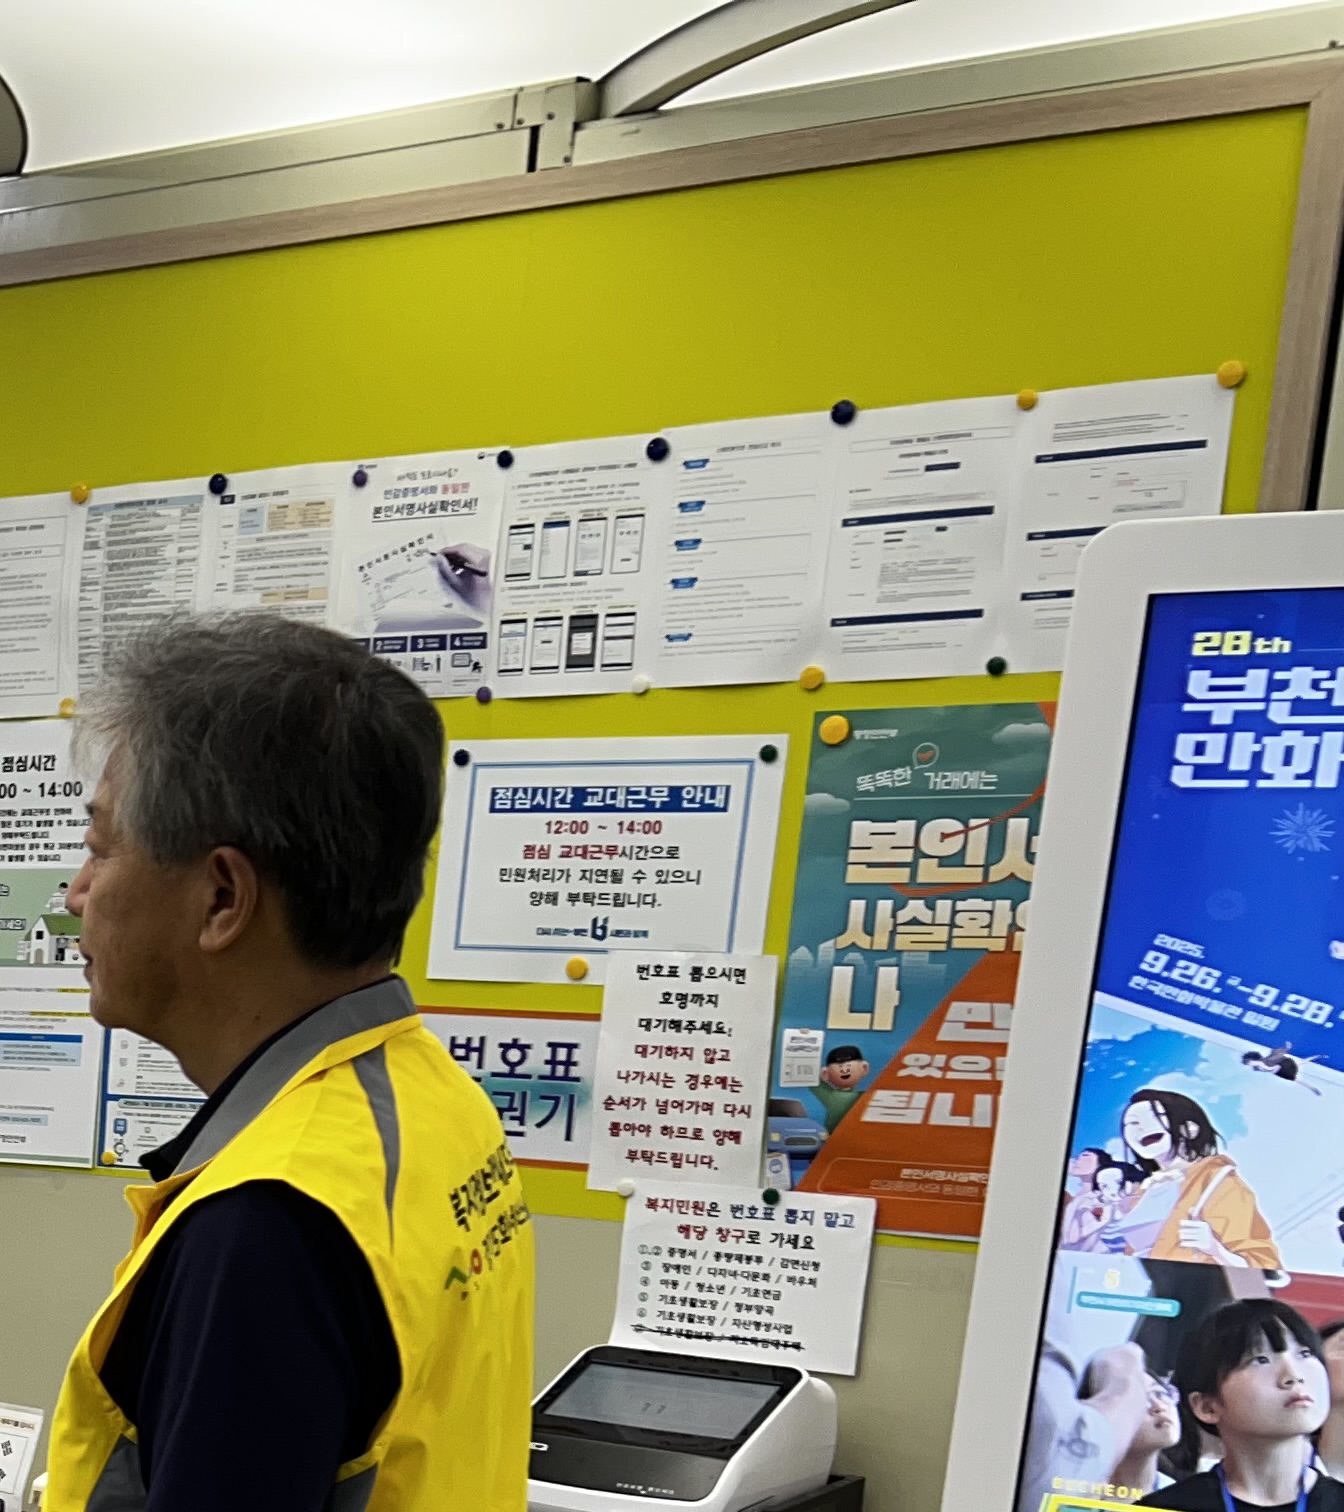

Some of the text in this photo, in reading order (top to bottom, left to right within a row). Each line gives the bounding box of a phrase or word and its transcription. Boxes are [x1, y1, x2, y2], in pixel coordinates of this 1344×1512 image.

[1190, 630, 1293, 657] 28th
[1, 754, 57, 773] 점심시간
[38, 781, 83, 798] 14:00
[855, 766, 999, 794] 똑똑한 거래에는
[493, 785, 728, 810] 점심시간 교대근무 안내
[545, 820, 663, 835] 12:00 14:00
[522, 844, 681, 860] 점심 교대근무시간으로
[499, 867, 701, 886] 민원처리가 지연될 수 있으니
[529, 891, 663, 909] 양해 부탁드립니다.
[1153, 933, 1205, 960] 2025.
[636, 963, 681, 980] 번호표
[658, 990, 720, 1008] 호명까지
[826, 965, 901, 1032] 나
[449, 1035, 582, 1083] 번호표
[634, 1044, 696, 1063] 대기하지
[617, 1069, 744, 1094] 나가시는 경우에는
[490, 1090, 576, 1142] 권기
[603, 1095, 753, 1120] 순서가 넘어가며 다시
[660, 1124, 705, 1143] 하므로
[713, 1127, 742, 1147] 양해
[625, 1148, 720, 1172] 부탁드립니다.
[645, 1197, 722, 1219] 복지민원은
[730, 1203, 776, 1222] 번호표
[824, 1211, 856, 1229] 말고
[677, 1223, 816, 1251] 해당 창구로 가세요
